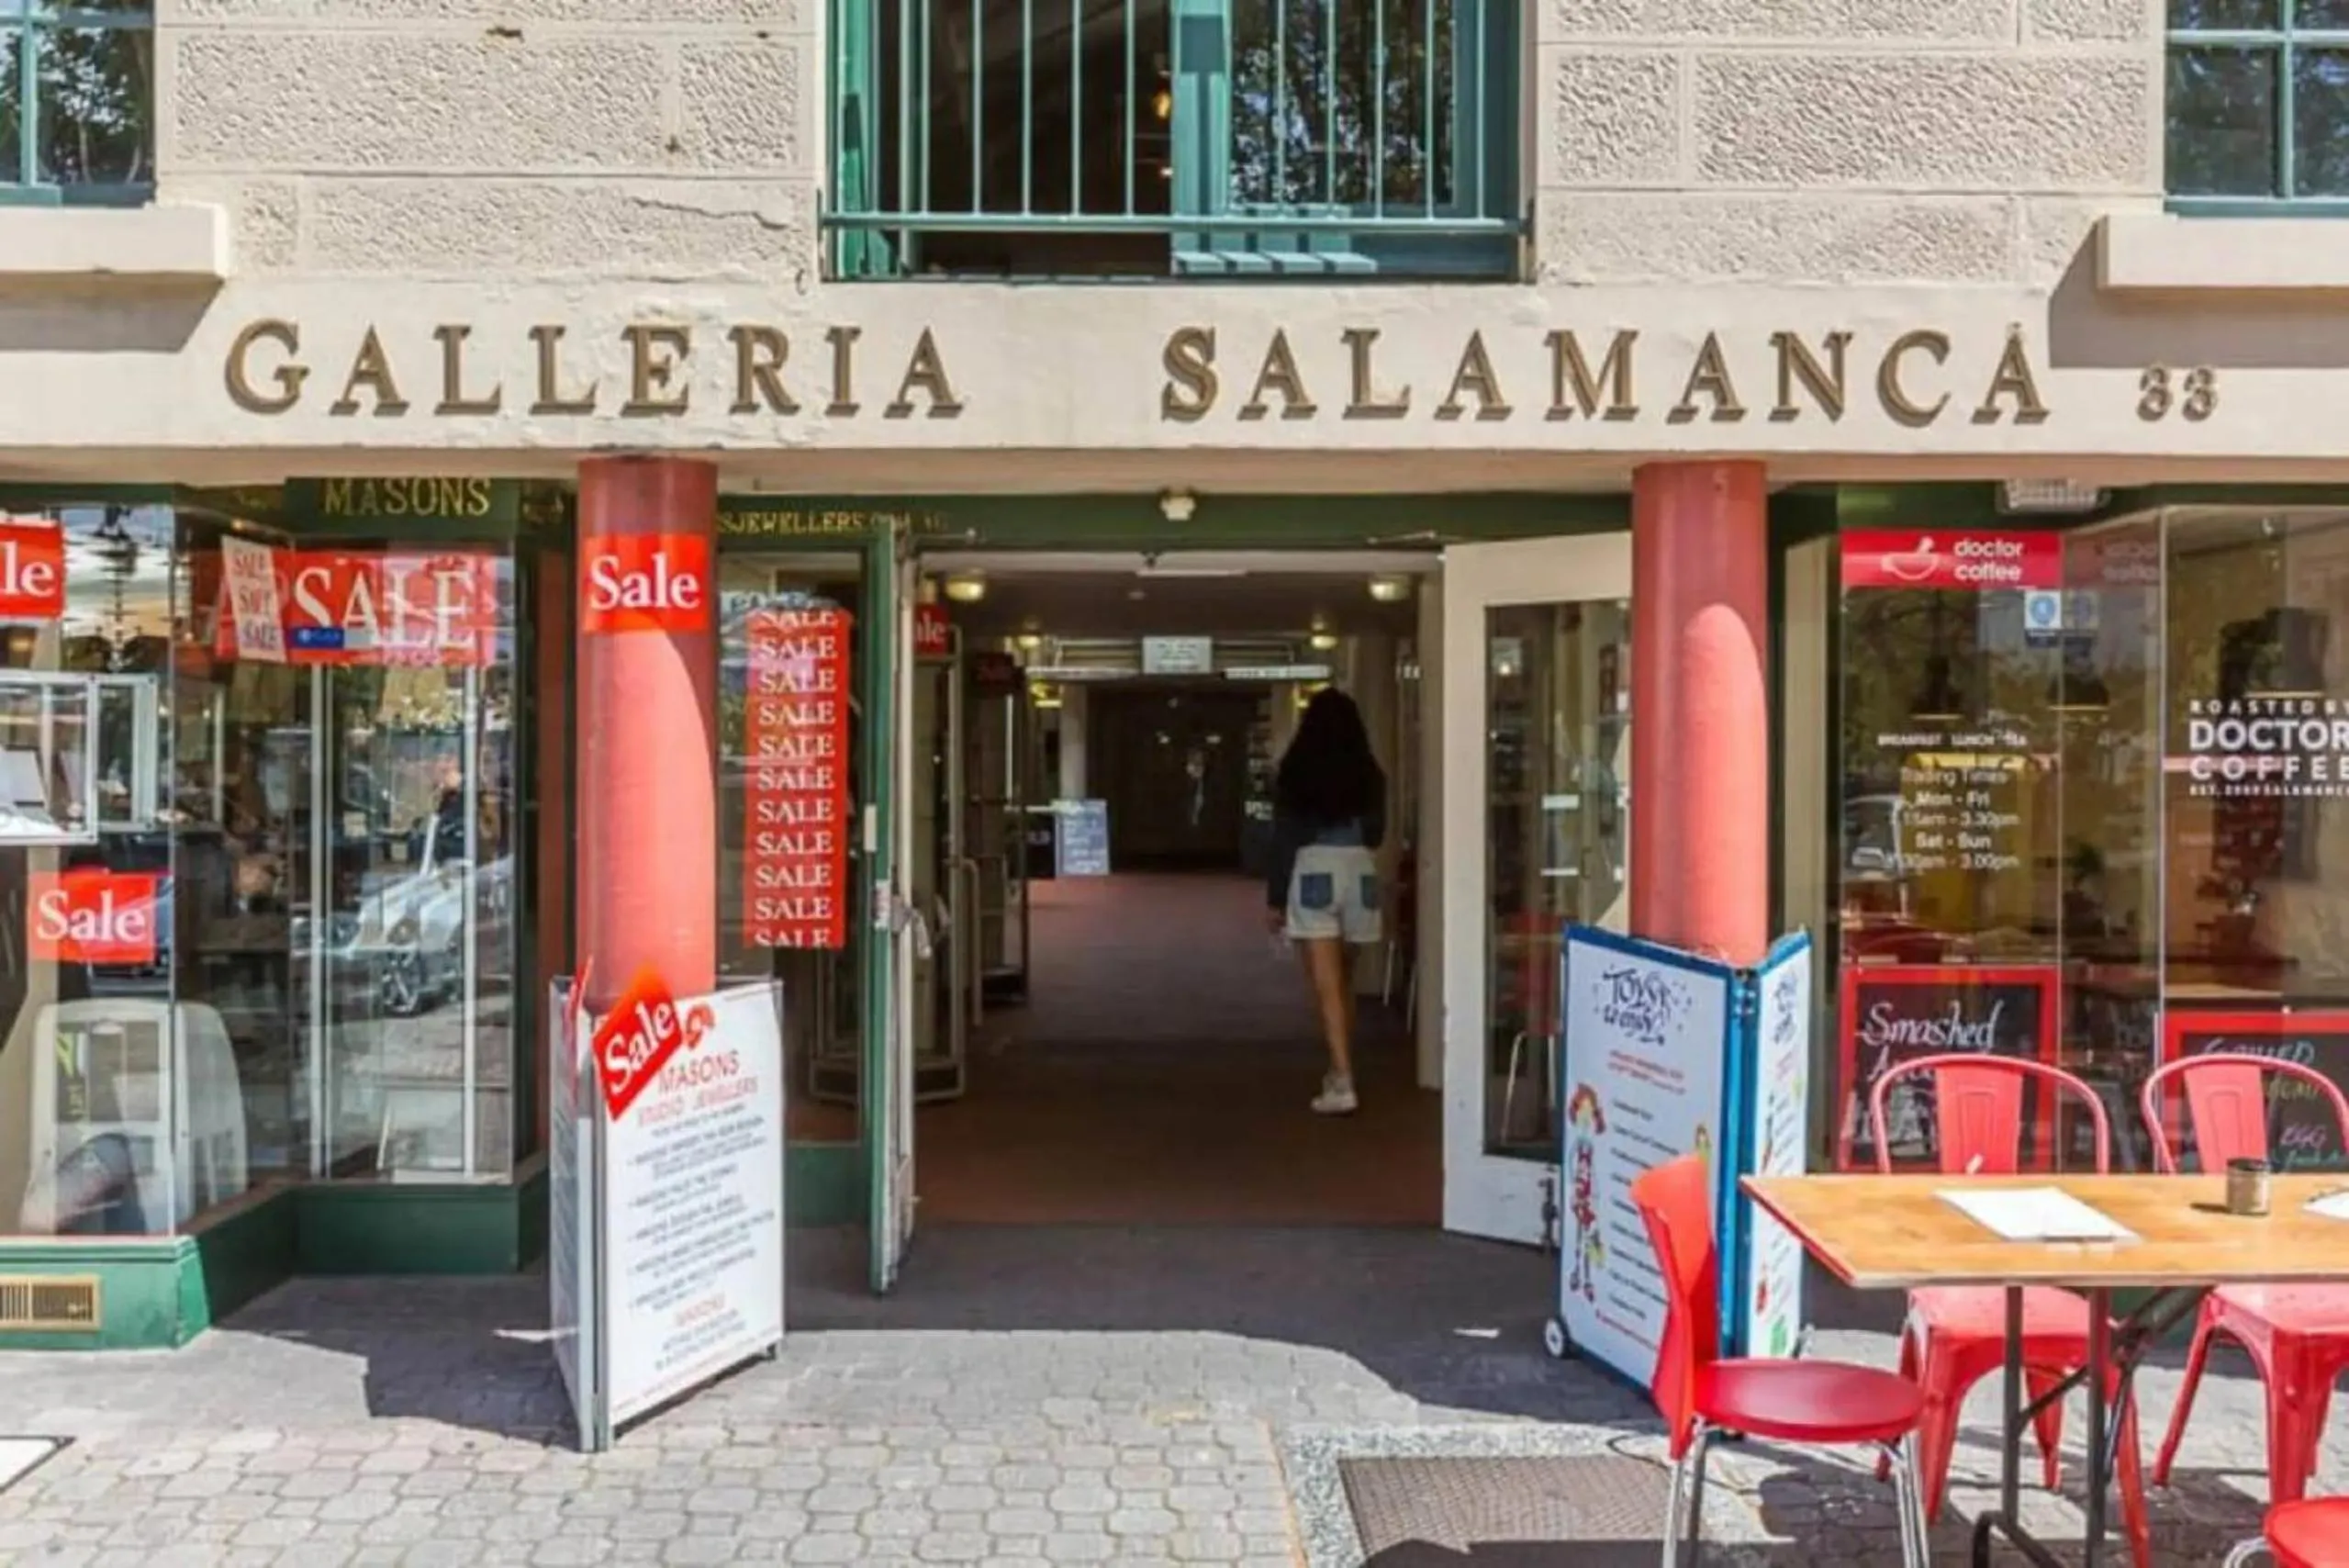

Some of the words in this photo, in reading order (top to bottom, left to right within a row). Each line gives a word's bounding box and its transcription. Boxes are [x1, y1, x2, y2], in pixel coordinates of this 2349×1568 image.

[224, 318, 964, 419] GALLERIA
[1160, 325, 2050, 425] SALAMANCA
[2136, 363, 2218, 421] 33
[324, 476, 491, 516] MASONS
[1954, 538, 2023, 556] doctor
[0, 542, 55, 598] le
[587, 552, 699, 610] Sale
[1954, 563, 2023, 581] coffee
[295, 563, 475, 648] SALE
[758, 635, 838, 660] SALE
[758, 669, 836, 693] SALE
[758, 700, 835, 725] SALE
[2189, 699, 2315, 715] ROASTED
[757, 734, 835, 759] SALE
[2189, 719, 2349, 751] DOCTOR
[757, 766, 834, 790] SALE
[2189, 756, 2349, 780] COFFEE
[1915, 790, 1952, 805] Mon
[1966, 790, 1991, 805] Fri
[756, 799, 834, 824] SALE
[755, 831, 833, 856] SALE
[1916, 832, 1943, 849] Sat
[1957, 832, 1992, 849] Sun
[755, 864, 833, 888] SALE
[35, 890, 147, 944] Sale
[755, 896, 833, 921] SALE
[1855, 999, 2005, 1053] Smashed
[604, 1001, 675, 1096] Sale
[658, 1048, 741, 1094] MASONS
